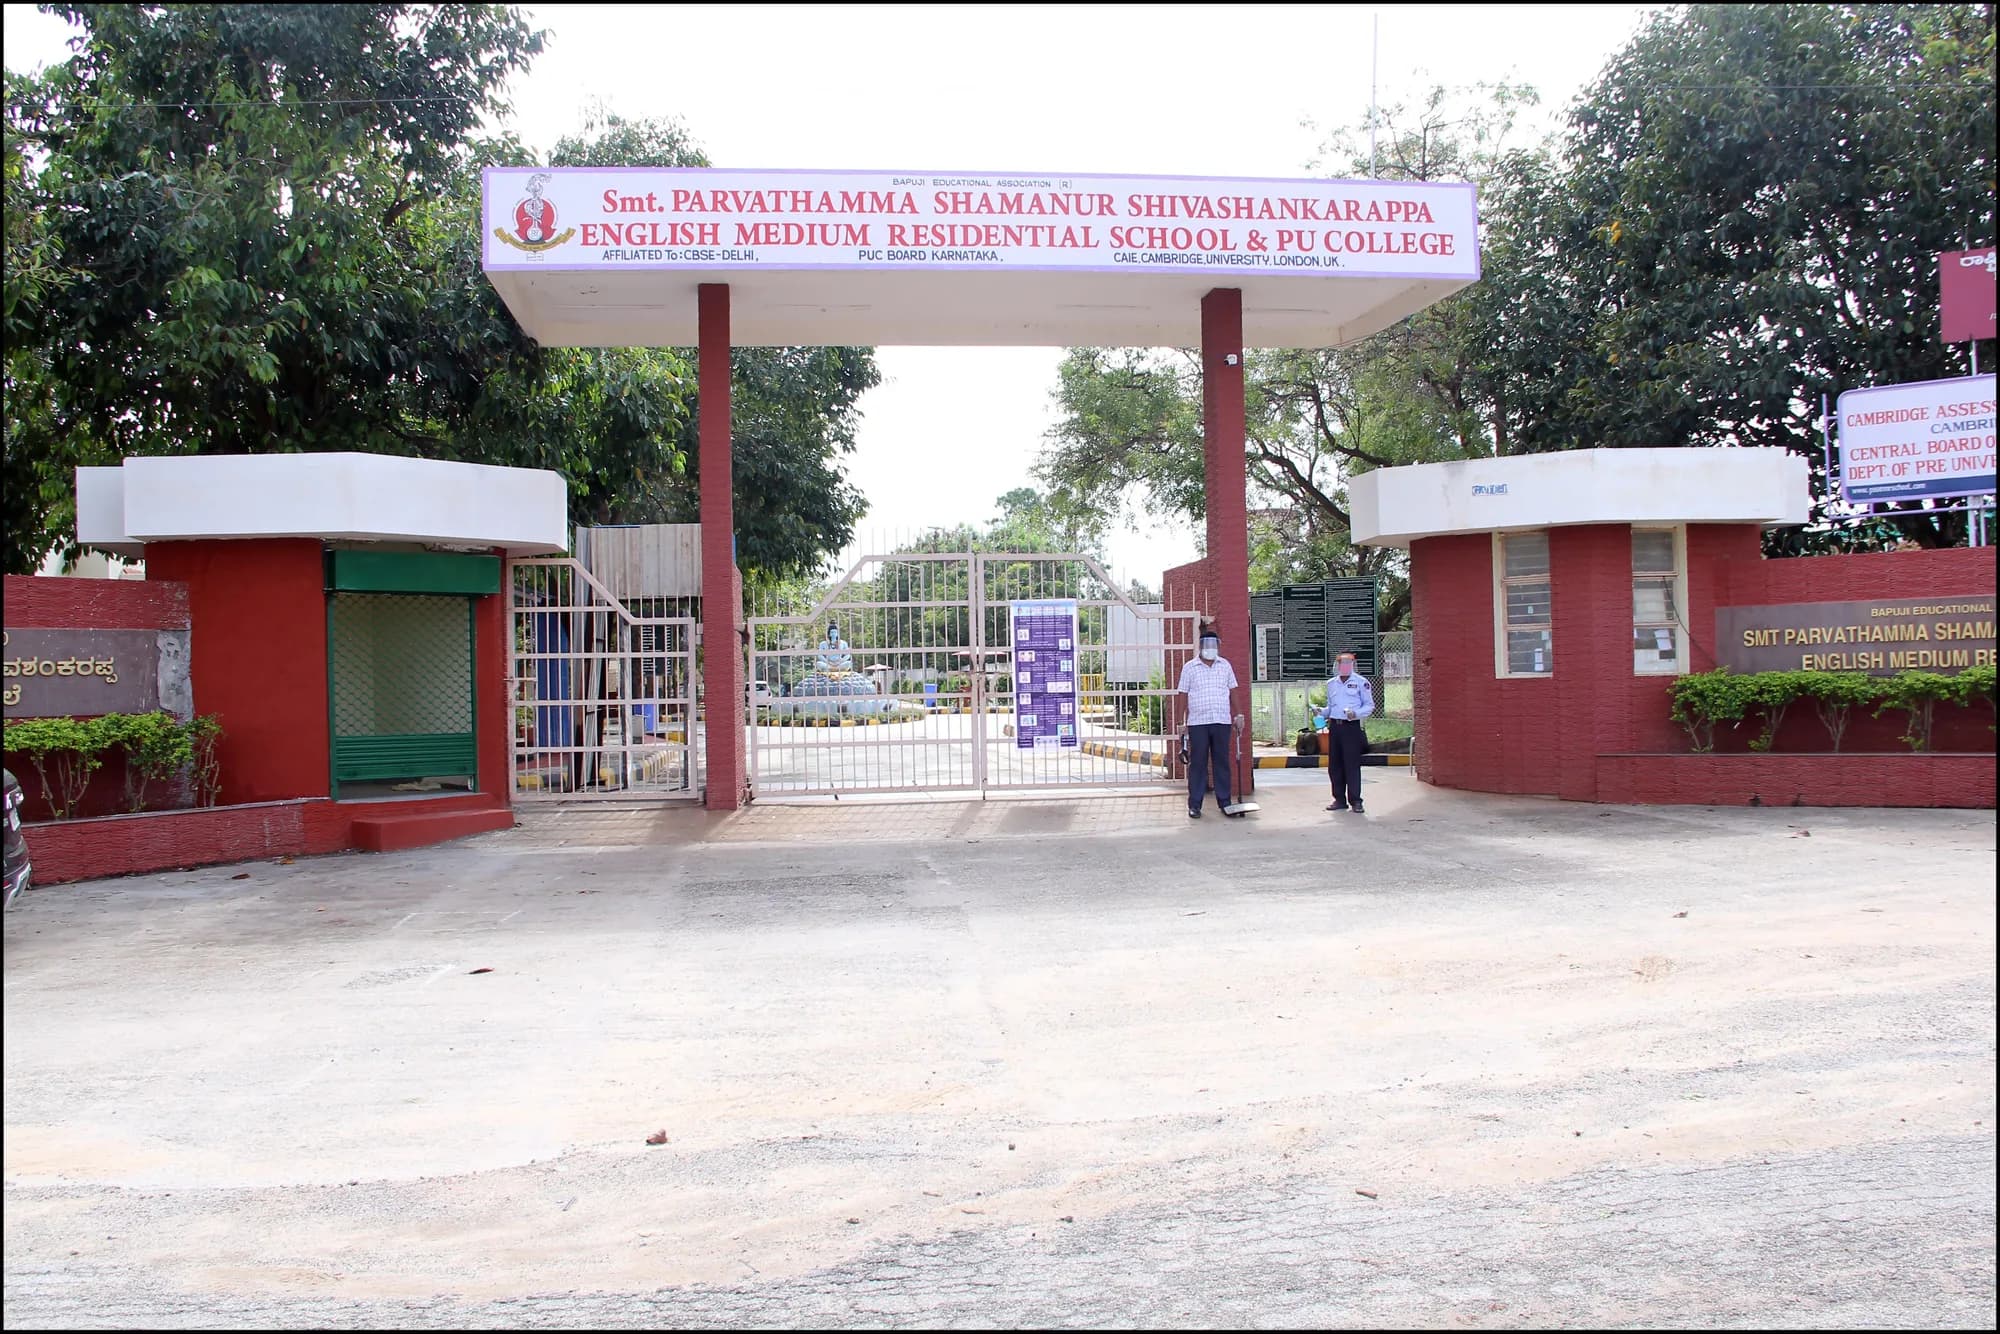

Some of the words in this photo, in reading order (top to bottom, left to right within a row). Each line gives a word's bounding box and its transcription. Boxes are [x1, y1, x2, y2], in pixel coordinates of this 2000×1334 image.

[893, 178, 925, 186] BAPUJI
[932, 178, 992, 187] EDUCATIONAL
[996, 179, 1051, 188] ASSOCIATION
[602, 189, 665, 213] Smt.
[672, 189, 920, 214] PARVATHAMMA
[934, 191, 1118, 216] SHAMANUR
[1128, 194, 1435, 223] SHIVASHANKARAPPA
[580, 222, 721, 246] ENGLISH
[733, 223, 872, 247] MEDIUM
[887, 224, 1100, 248] RESIDENTIAL
[1109, 226, 1238, 251] SCHOOL
[1246, 229, 1268, 252] &
[1276, 229, 1317, 252] PU
[1324, 230, 1455, 256] COLLEGE
[602, 249, 662, 261] AFFILIATED
[859, 249, 883, 261] PUC
[887, 250, 927, 261] BOARD
[1847, 407, 1929, 427] CAMBRIDGE
[1930, 419, 1994, 434] CAMBRI
[1850, 443, 1921, 461] CENTRAL
[1927, 437, 1981, 454] BOARD
[1916, 459, 1947, 475] PRE
[1871, 607, 1910, 618] BAPUJI
[1912, 603, 1993, 615] EDUCATIONAL
[1743, 628, 1780, 647] SMT
[1784, 623, 1929, 646] PARVATHAMMA
[1802, 651, 1884, 671] ENGLISH
[1889, 649, 1969, 669] MEDIUM
